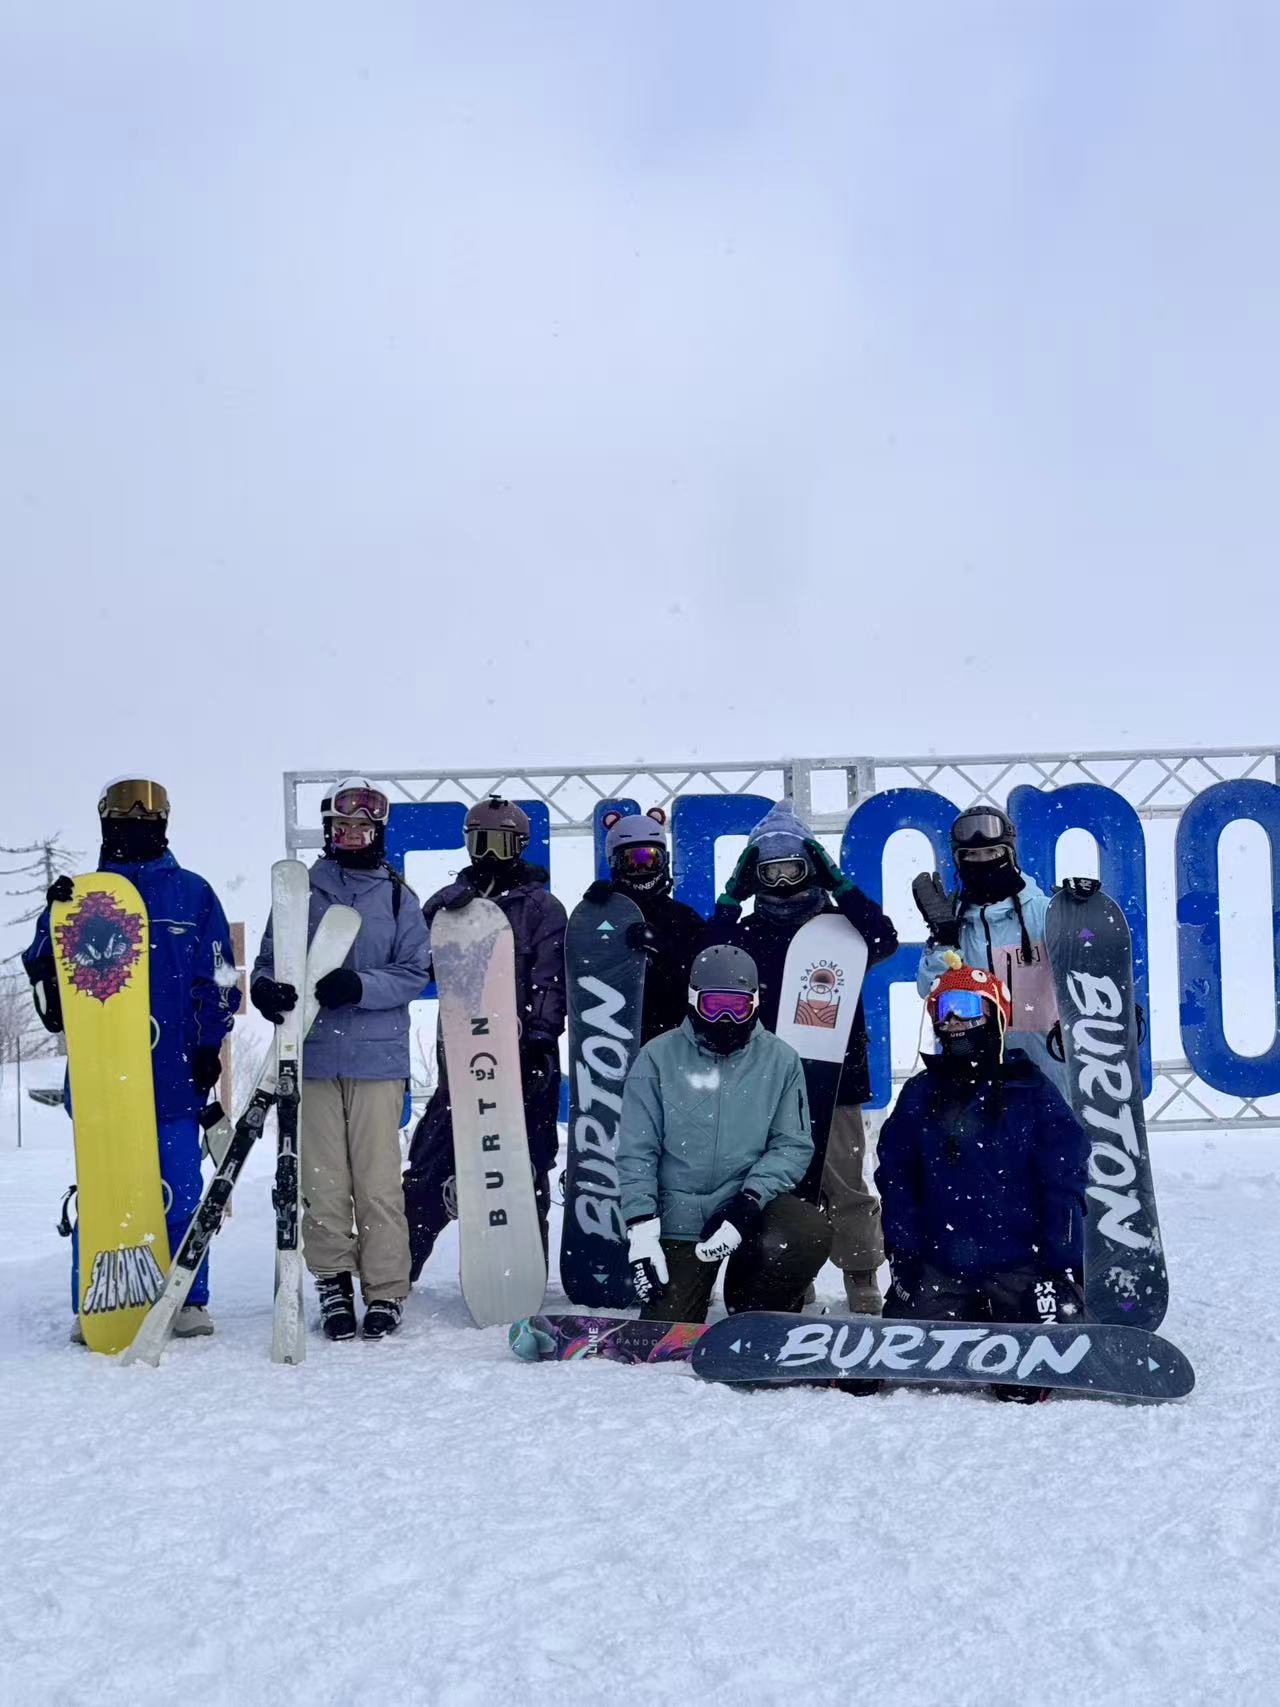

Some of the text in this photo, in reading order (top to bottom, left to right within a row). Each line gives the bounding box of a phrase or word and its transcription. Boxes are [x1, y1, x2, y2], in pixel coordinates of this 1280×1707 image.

[384, 778, 1280, 1128] ANO
[800, 959, 844, 987] SALOMON
[574, 975, 634, 1244] BURTON
[1066, 970, 1151, 1250] BURTON
[82, 1245, 165, 1315] SALOMON
[587, 1327, 599, 1354] LINE
[776, 1324, 1091, 1379] BURTON
